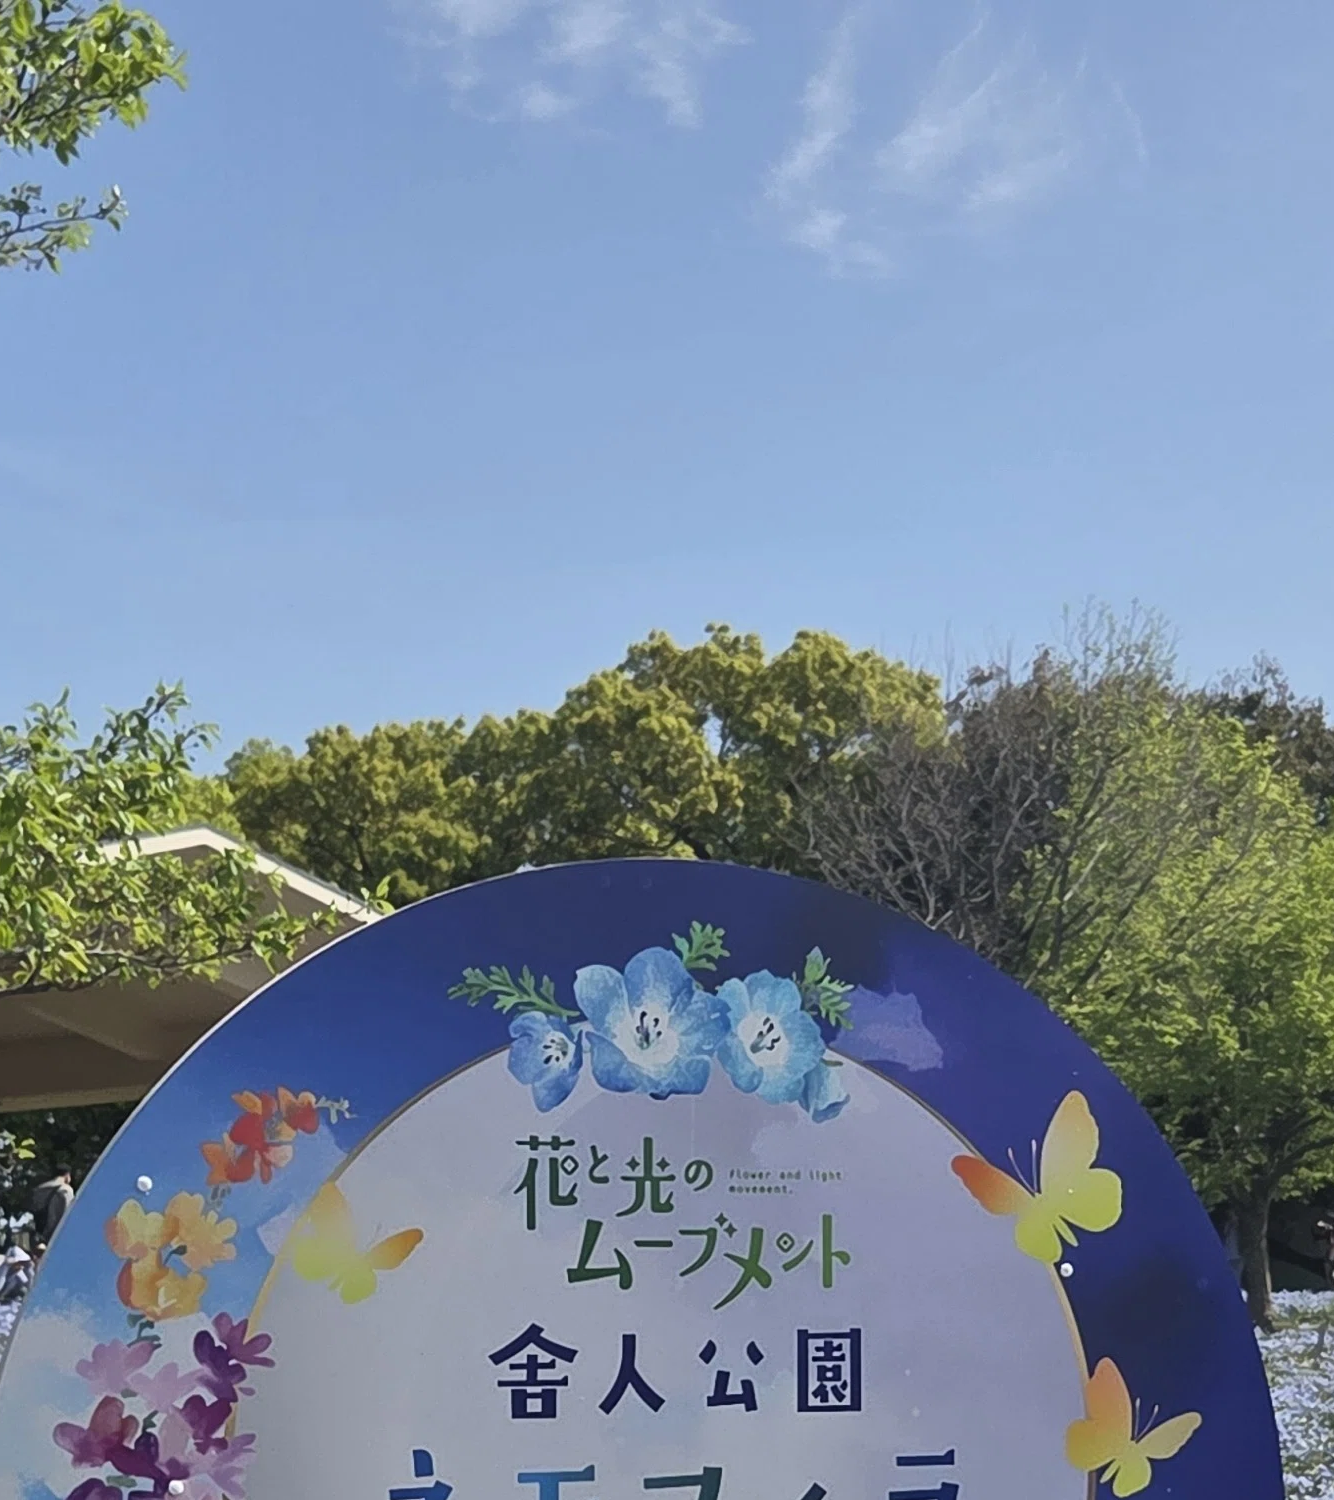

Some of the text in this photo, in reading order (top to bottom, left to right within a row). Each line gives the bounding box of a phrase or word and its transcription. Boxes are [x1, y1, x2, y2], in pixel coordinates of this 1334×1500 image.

[514, 1135, 714, 1231] 花と光の
[567, 1213, 852, 1310] ムーブメント
[488, 1323, 863, 1420] 舎人公園
